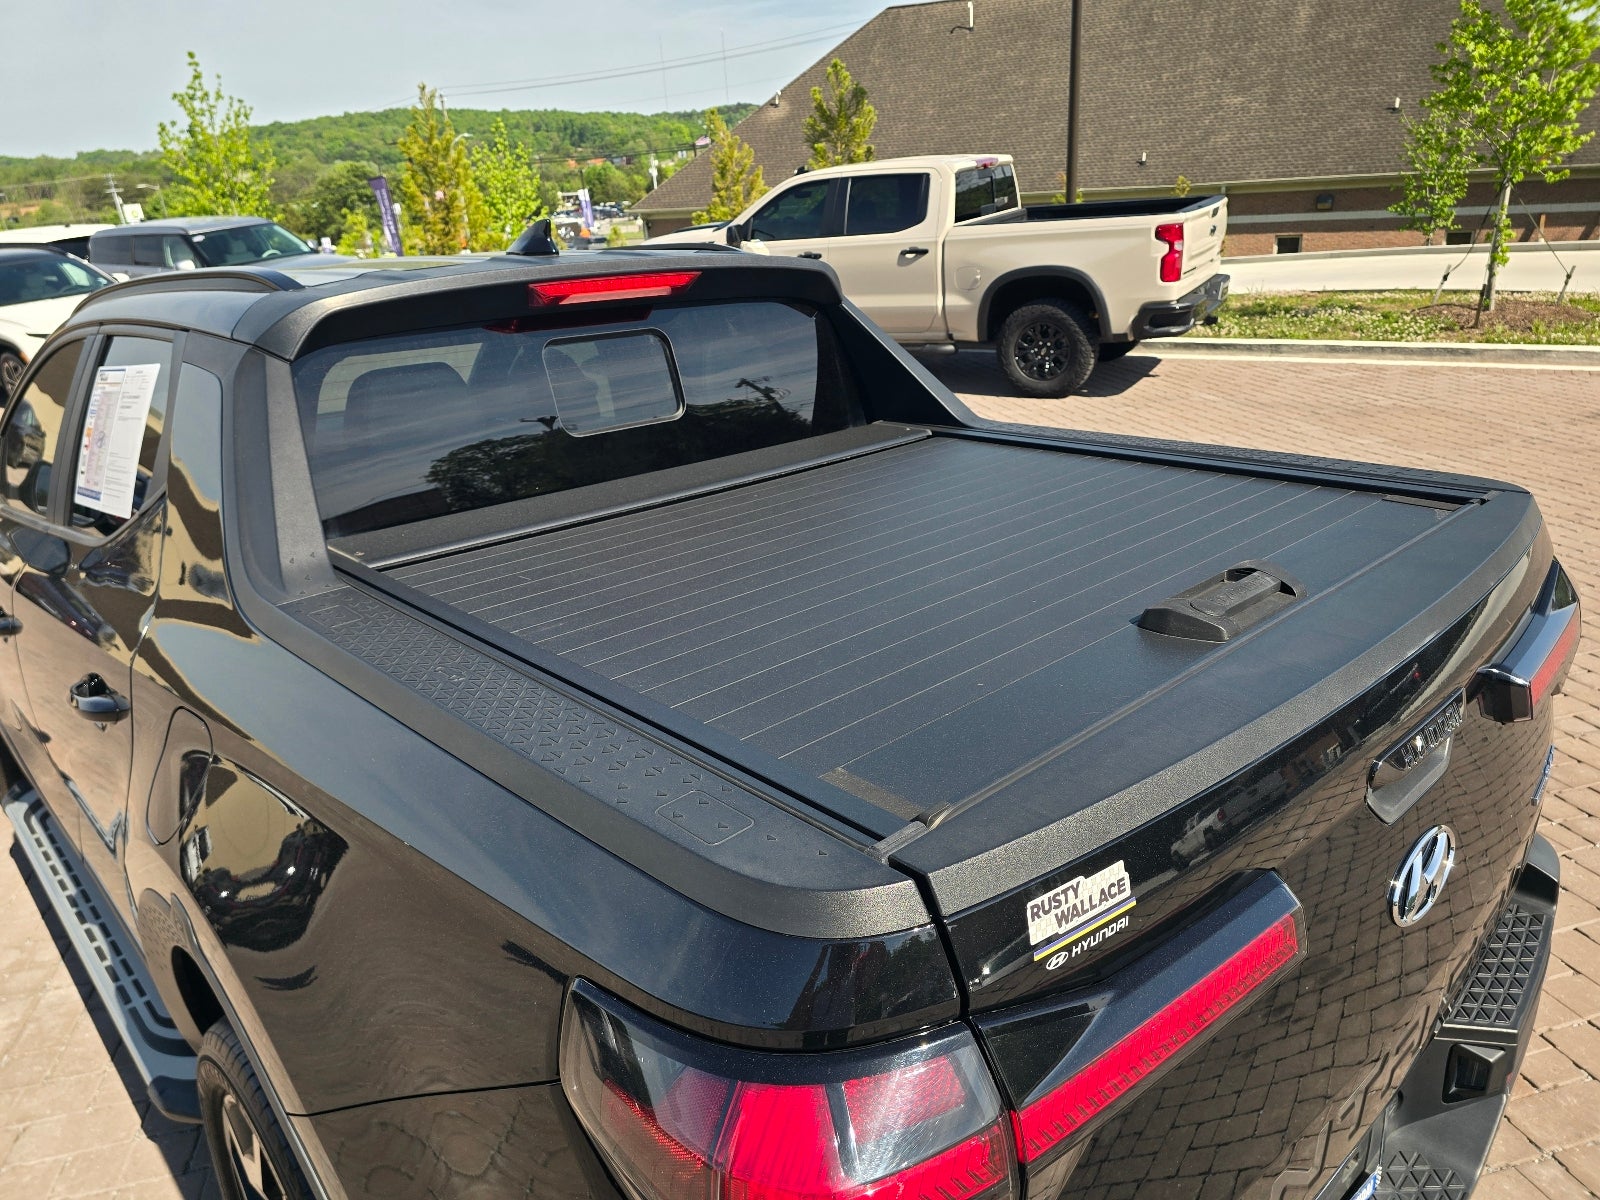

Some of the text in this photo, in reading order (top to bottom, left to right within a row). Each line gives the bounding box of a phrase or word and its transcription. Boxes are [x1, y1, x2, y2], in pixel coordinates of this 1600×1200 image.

[1030, 880, 1081, 922] RUSTY
[1055, 877, 1126, 928] WALLACE
[1071, 915, 1129, 958] HYUNDAI
